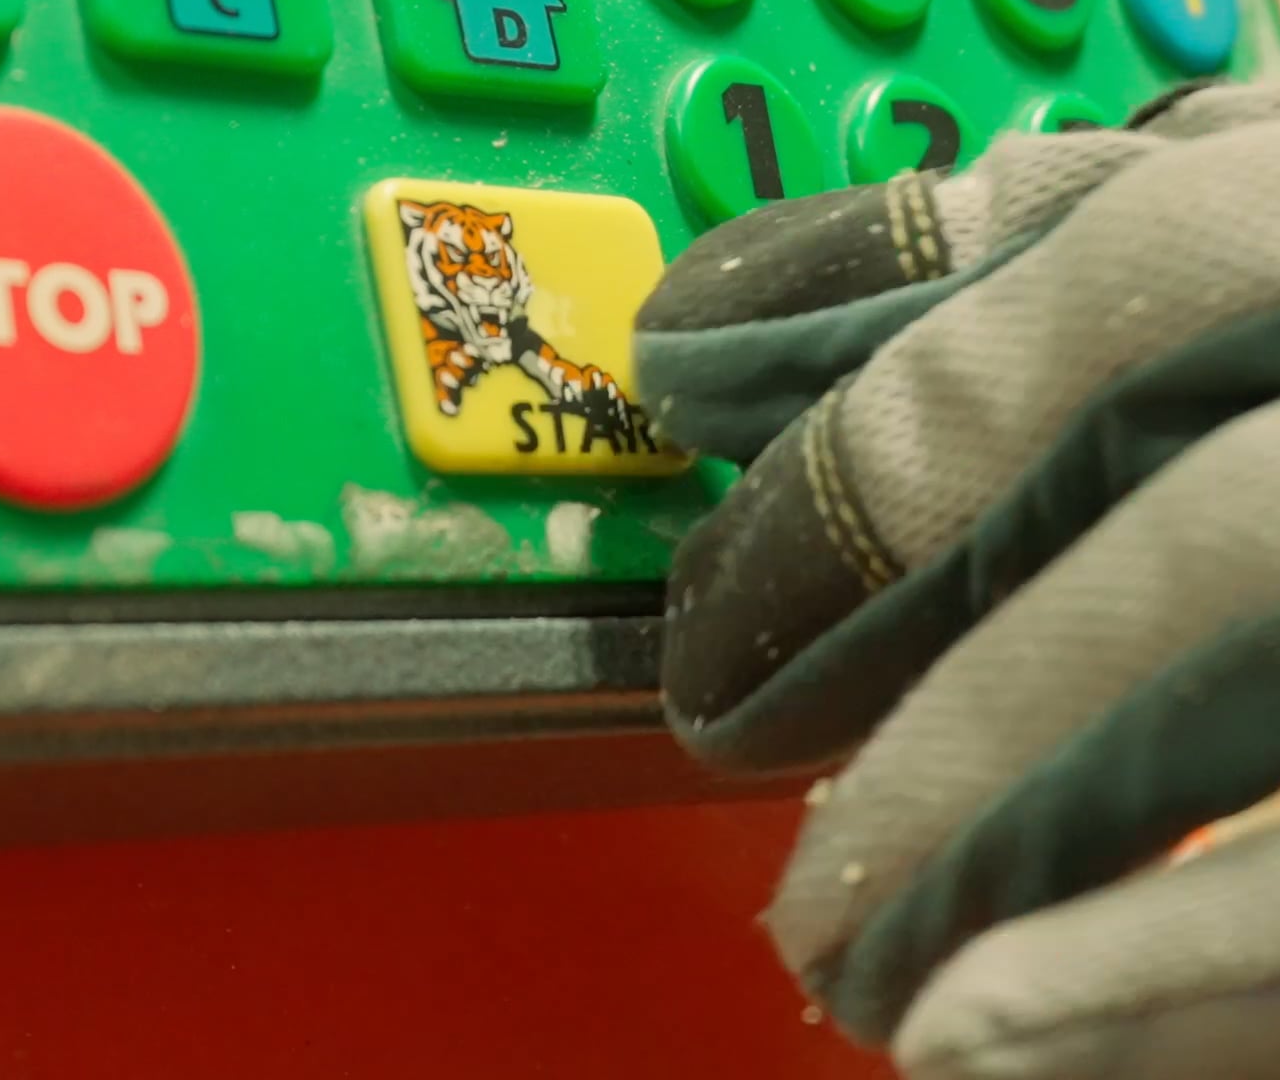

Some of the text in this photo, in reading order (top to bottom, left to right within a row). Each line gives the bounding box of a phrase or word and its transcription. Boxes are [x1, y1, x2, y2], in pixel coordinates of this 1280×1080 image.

[492, 6, 531, 51] D
[721, 82, 786, 202] 1
[511, 401, 659, 455] STAR
